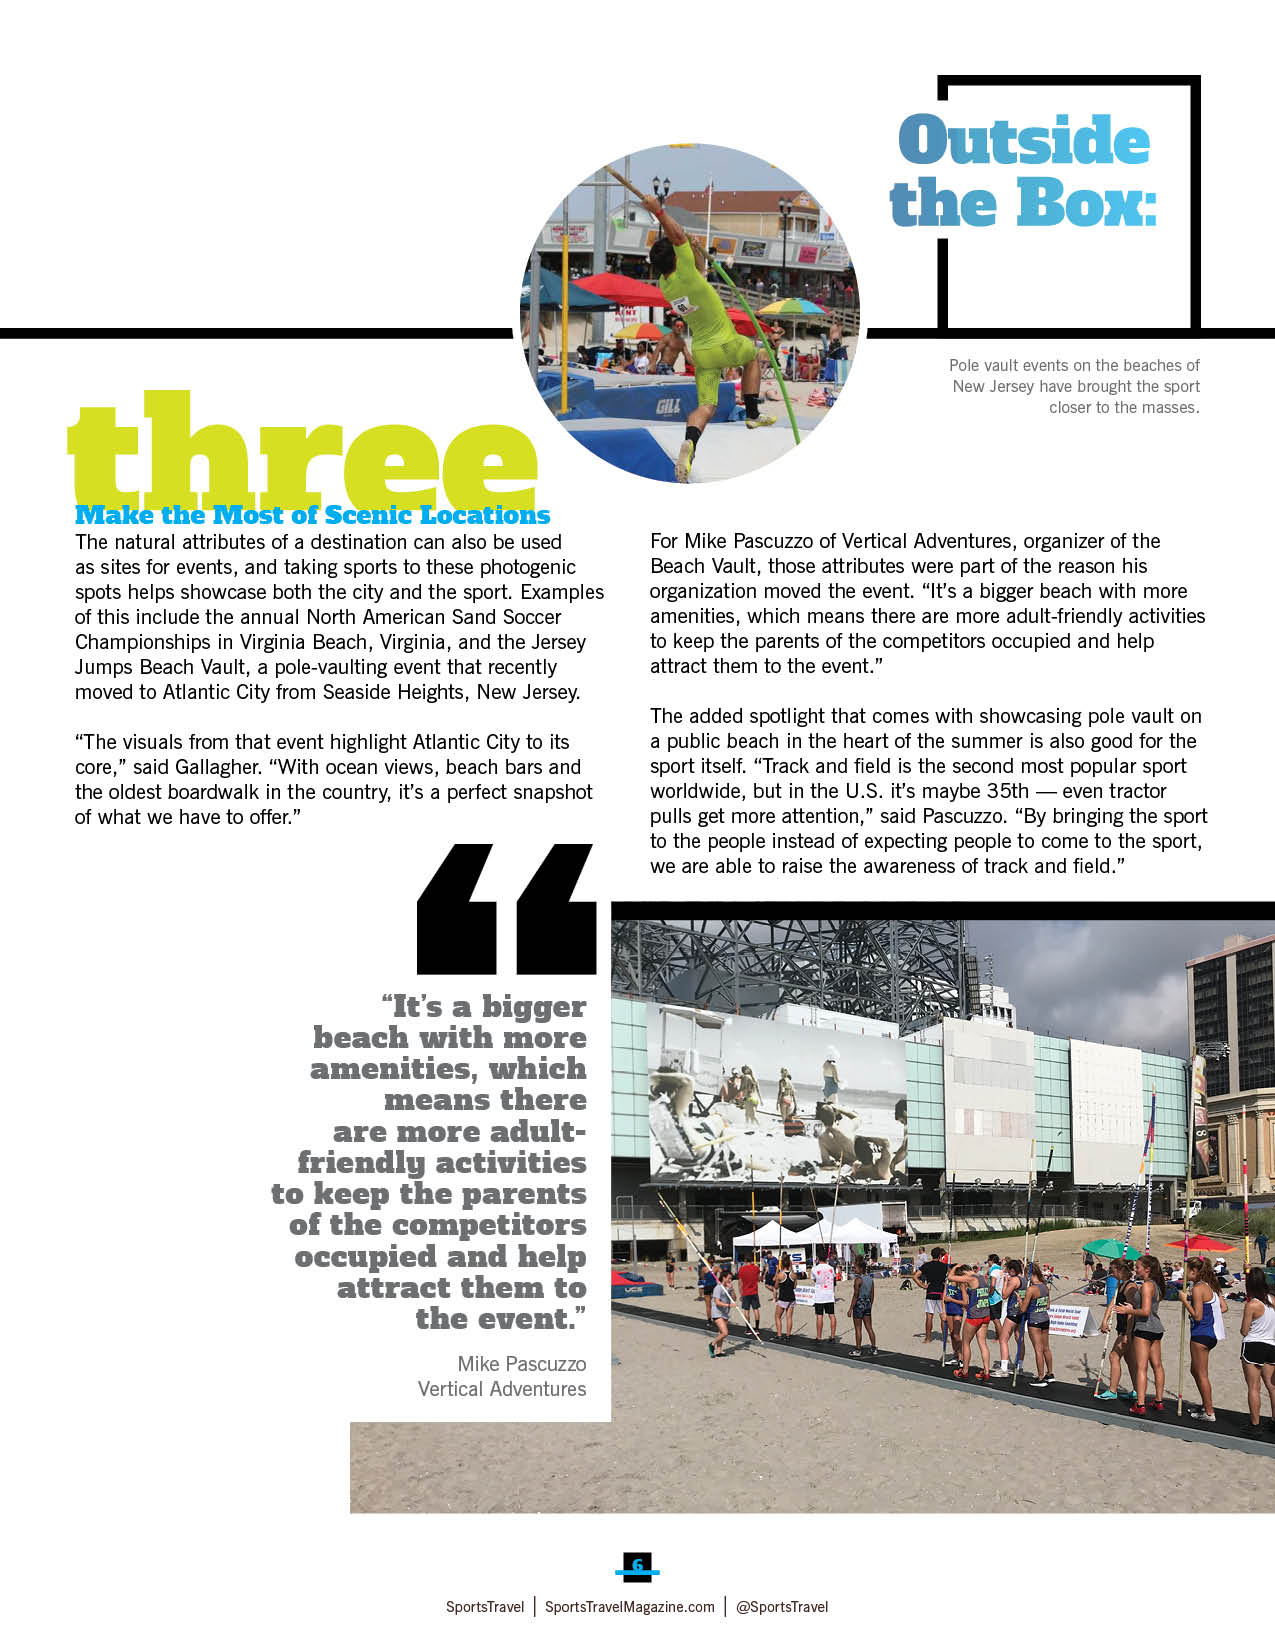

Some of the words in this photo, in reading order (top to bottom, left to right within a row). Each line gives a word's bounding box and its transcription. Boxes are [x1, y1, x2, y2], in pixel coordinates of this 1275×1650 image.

[898, 112, 1150, 165] Outside
[889, 176, 998, 227] the
[1016, 176, 1157, 227] Box:
[950, 358, 979, 372] Pole
[984, 358, 1019, 372] vault
[1023, 359, 1069, 372] events
[1073, 361, 1091, 372] on
[1095, 358, 1119, 372] the
[1123, 358, 1182, 372] beaches
[1186, 358, 1201, 372] of
[953, 379, 985, 393] New
[989, 379, 1034, 396] Jersey
[1040, 379, 1072, 393] have
[1077, 379, 1132, 396] brought
[1136, 379, 1159, 393] the
[1164, 380, 1201, 396] sport
[656, 398, 681, 415] GILL
[1049, 400, 1092, 414] closer
[1095, 401, 1110, 414] to
[1114, 400, 1137, 414] the
[1142, 403, 1200, 414] masses.
[66, 389, 539, 511] three
[75, 505, 154, 525] Make
[161, 505, 205, 525] the
[213, 505, 284, 525] Most
[291, 505, 319, 525] of
[325, 504, 412, 525] Scenic
[420, 505, 551, 525] Locations
[74, 533, 108, 550] The
[115, 533, 175, 550] natural
[182, 533, 266, 550] attributes
[271, 533, 289, 550] of
[294, 537, 304, 550] a
[310, 533, 407, 550] destination
[413, 537, 445, 550] can
[451, 533, 487, 550] also
[493, 533, 515, 550] be
[521, 533, 562, 550] used
[651, 532, 679, 549] For
[685, 532, 727, 549] Mike
[734, 532, 814, 549] Pascuzzo
[819, 532, 837, 549] of
[841, 532, 907, 549] Vertical
[913, 532, 1017, 552] Adventures,
[1023, 532, 1105, 553] organizer
[1110, 532, 1127, 549] of
[1131, 532, 1161, 549] the
[74, 608, 92, 625] of
[96, 608, 130, 625] this
[136, 608, 200, 625] include
[204, 608, 234, 625] the
[240, 608, 299, 625] annual
[307, 608, 356, 625] North
[362, 608, 445, 625] American
[452, 608, 496, 625] Sand
[503, 608, 562, 625] Soccer
[75, 683, 133, 700] moved
[138, 683, 157, 700] to
[162, 683, 231, 700] Atlantic
[236, 683, 271, 704] City
[275, 683, 316, 700] from
[323, 683, 391, 700] Seaside
[398, 683, 469, 704] Heights,
[477, 683, 517, 700] New
[522, 683, 580, 704] Jersey.
[649, 707, 683, 724] The
[689, 707, 743, 724] added
[749, 707, 826, 728] spotlight
[830, 707, 867, 724] that
[872, 711, 930, 724] comes
[934, 707, 973, 724] with
[979, 707, 1082, 728] showcasing
[1088, 707, 1125, 728] pole
[1131, 707, 1175, 724] vault
[1180, 711, 1202, 724] on
[649, 782, 746, 802] worldwide,
[753, 782, 782, 799] but
[789, 782, 804, 799] in
[809, 782, 839, 799] the
[846, 782, 883, 799] U.S.
[891, 782, 916, 799] it’s
[922, 782, 981, 803] maybe
[987, 782, 1029, 799] 35th
[1062, 786, 1103, 799] even
[1108, 782, 1168, 799] tractor
[74, 808, 92, 825] of
[97, 808, 142, 825] what
[146, 812, 173, 825] we
[179, 808, 221, 825] have
[225, 808, 244, 825] to
[249, 808, 301, 825] offer.”
[650, 807, 692, 828] pulls
[697, 807, 726, 828] get
[731, 811, 776, 824] more
[781, 807, 873, 827] attention,”
[880, 807, 916, 824] said
[923, 807, 1007, 824] Pascuzzo.
[1015, 807, 1047, 828] “By
[1052, 807, 1124, 828] bringing
[1128, 807, 1158, 824] the
[1163, 807, 1209, 828] sport
[382, 993, 443, 1018] “It’s
[452, 1000, 472, 1018] a
[482, 993, 587, 1024] bigger
[313, 1024, 409, 1049] beach
[419, 1024, 494, 1049] with
[503, 1031, 587, 1049] more
[310, 1055, 478, 1085] amenities,
[488, 1055, 587, 1080] which
[384, 1093, 491, 1111] means
[500, 1086, 587, 1111] there
[333, 1125, 387, 1143] are
[397, 1125, 481, 1143] more
[490, 1118, 586, 1143] adult-
[298, 1149, 425, 1180] friendly
[435, 1149, 587, 1174] activities
[271, 1183, 304, 1205] to
[314, 1180, 390, 1211] keep
[399, 1180, 453, 1205] the
[462, 1183, 587, 1211] parents
[289, 1211, 322, 1236] of
[329, 1211, 382, 1236] the
[392, 1211, 587, 1242] competitors
[294, 1243, 437, 1274] occupied
[447, 1243, 508, 1268] and
[518, 1243, 587, 1274] help
[337, 1277, 451, 1299] attract
[460, 1274, 545, 1299] them
[554, 1277, 587, 1299] to
[415, 1305, 468, 1330] the
[478, 1305, 586, 1330] event.”
[458, 1355, 500, 1372] Mike
[506, 1355, 587, 1372] Pascuzzo
[418, 1380, 483, 1397] Vertical
[489, 1380, 587, 1397] Adventures
[632, 1558, 644, 1574] 6
[446, 1600, 525, 1616] SportsTravel
[545, 1600, 715, 1616] SportsTravelMagazine.com
[736, 1600, 829, 1616] @SportsTravel
